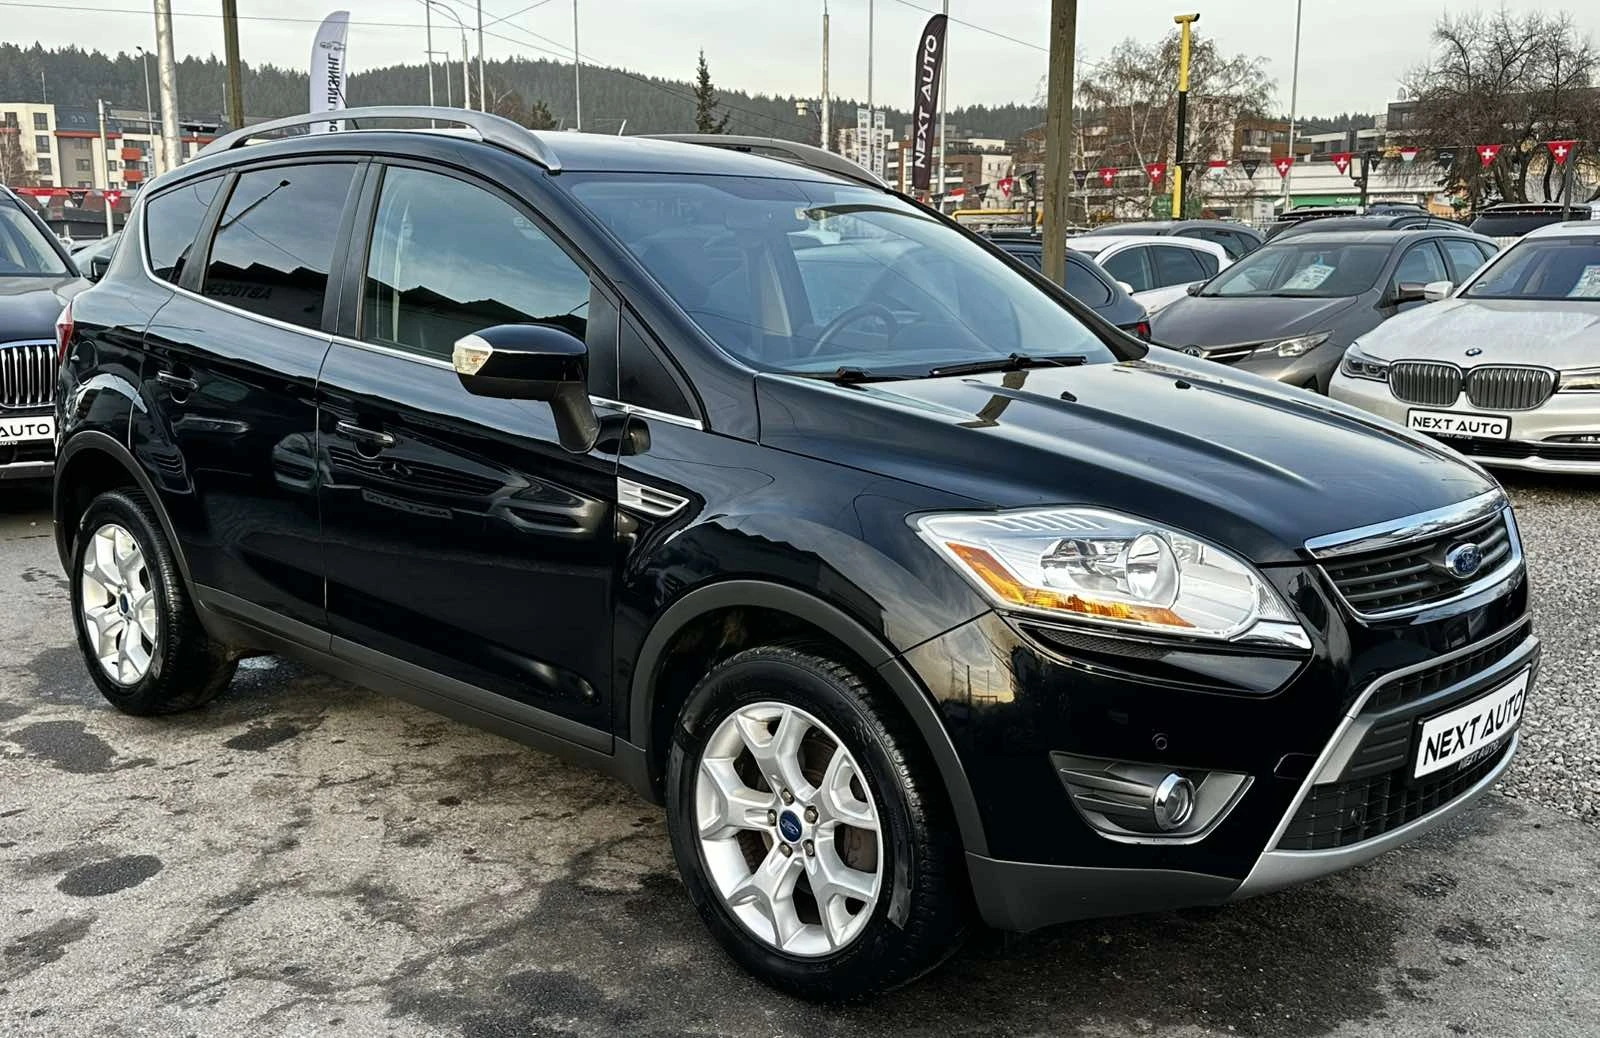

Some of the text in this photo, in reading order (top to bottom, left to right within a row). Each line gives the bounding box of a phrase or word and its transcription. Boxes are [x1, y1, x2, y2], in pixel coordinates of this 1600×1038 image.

[914, 34, 937, 168] NEXT AUTO
[1412, 416, 1503, 435] NEXT AUTO
[1423, 688, 1523, 766] NEXT AUTO
[1458, 740, 1500, 771] NEXT AUTO
